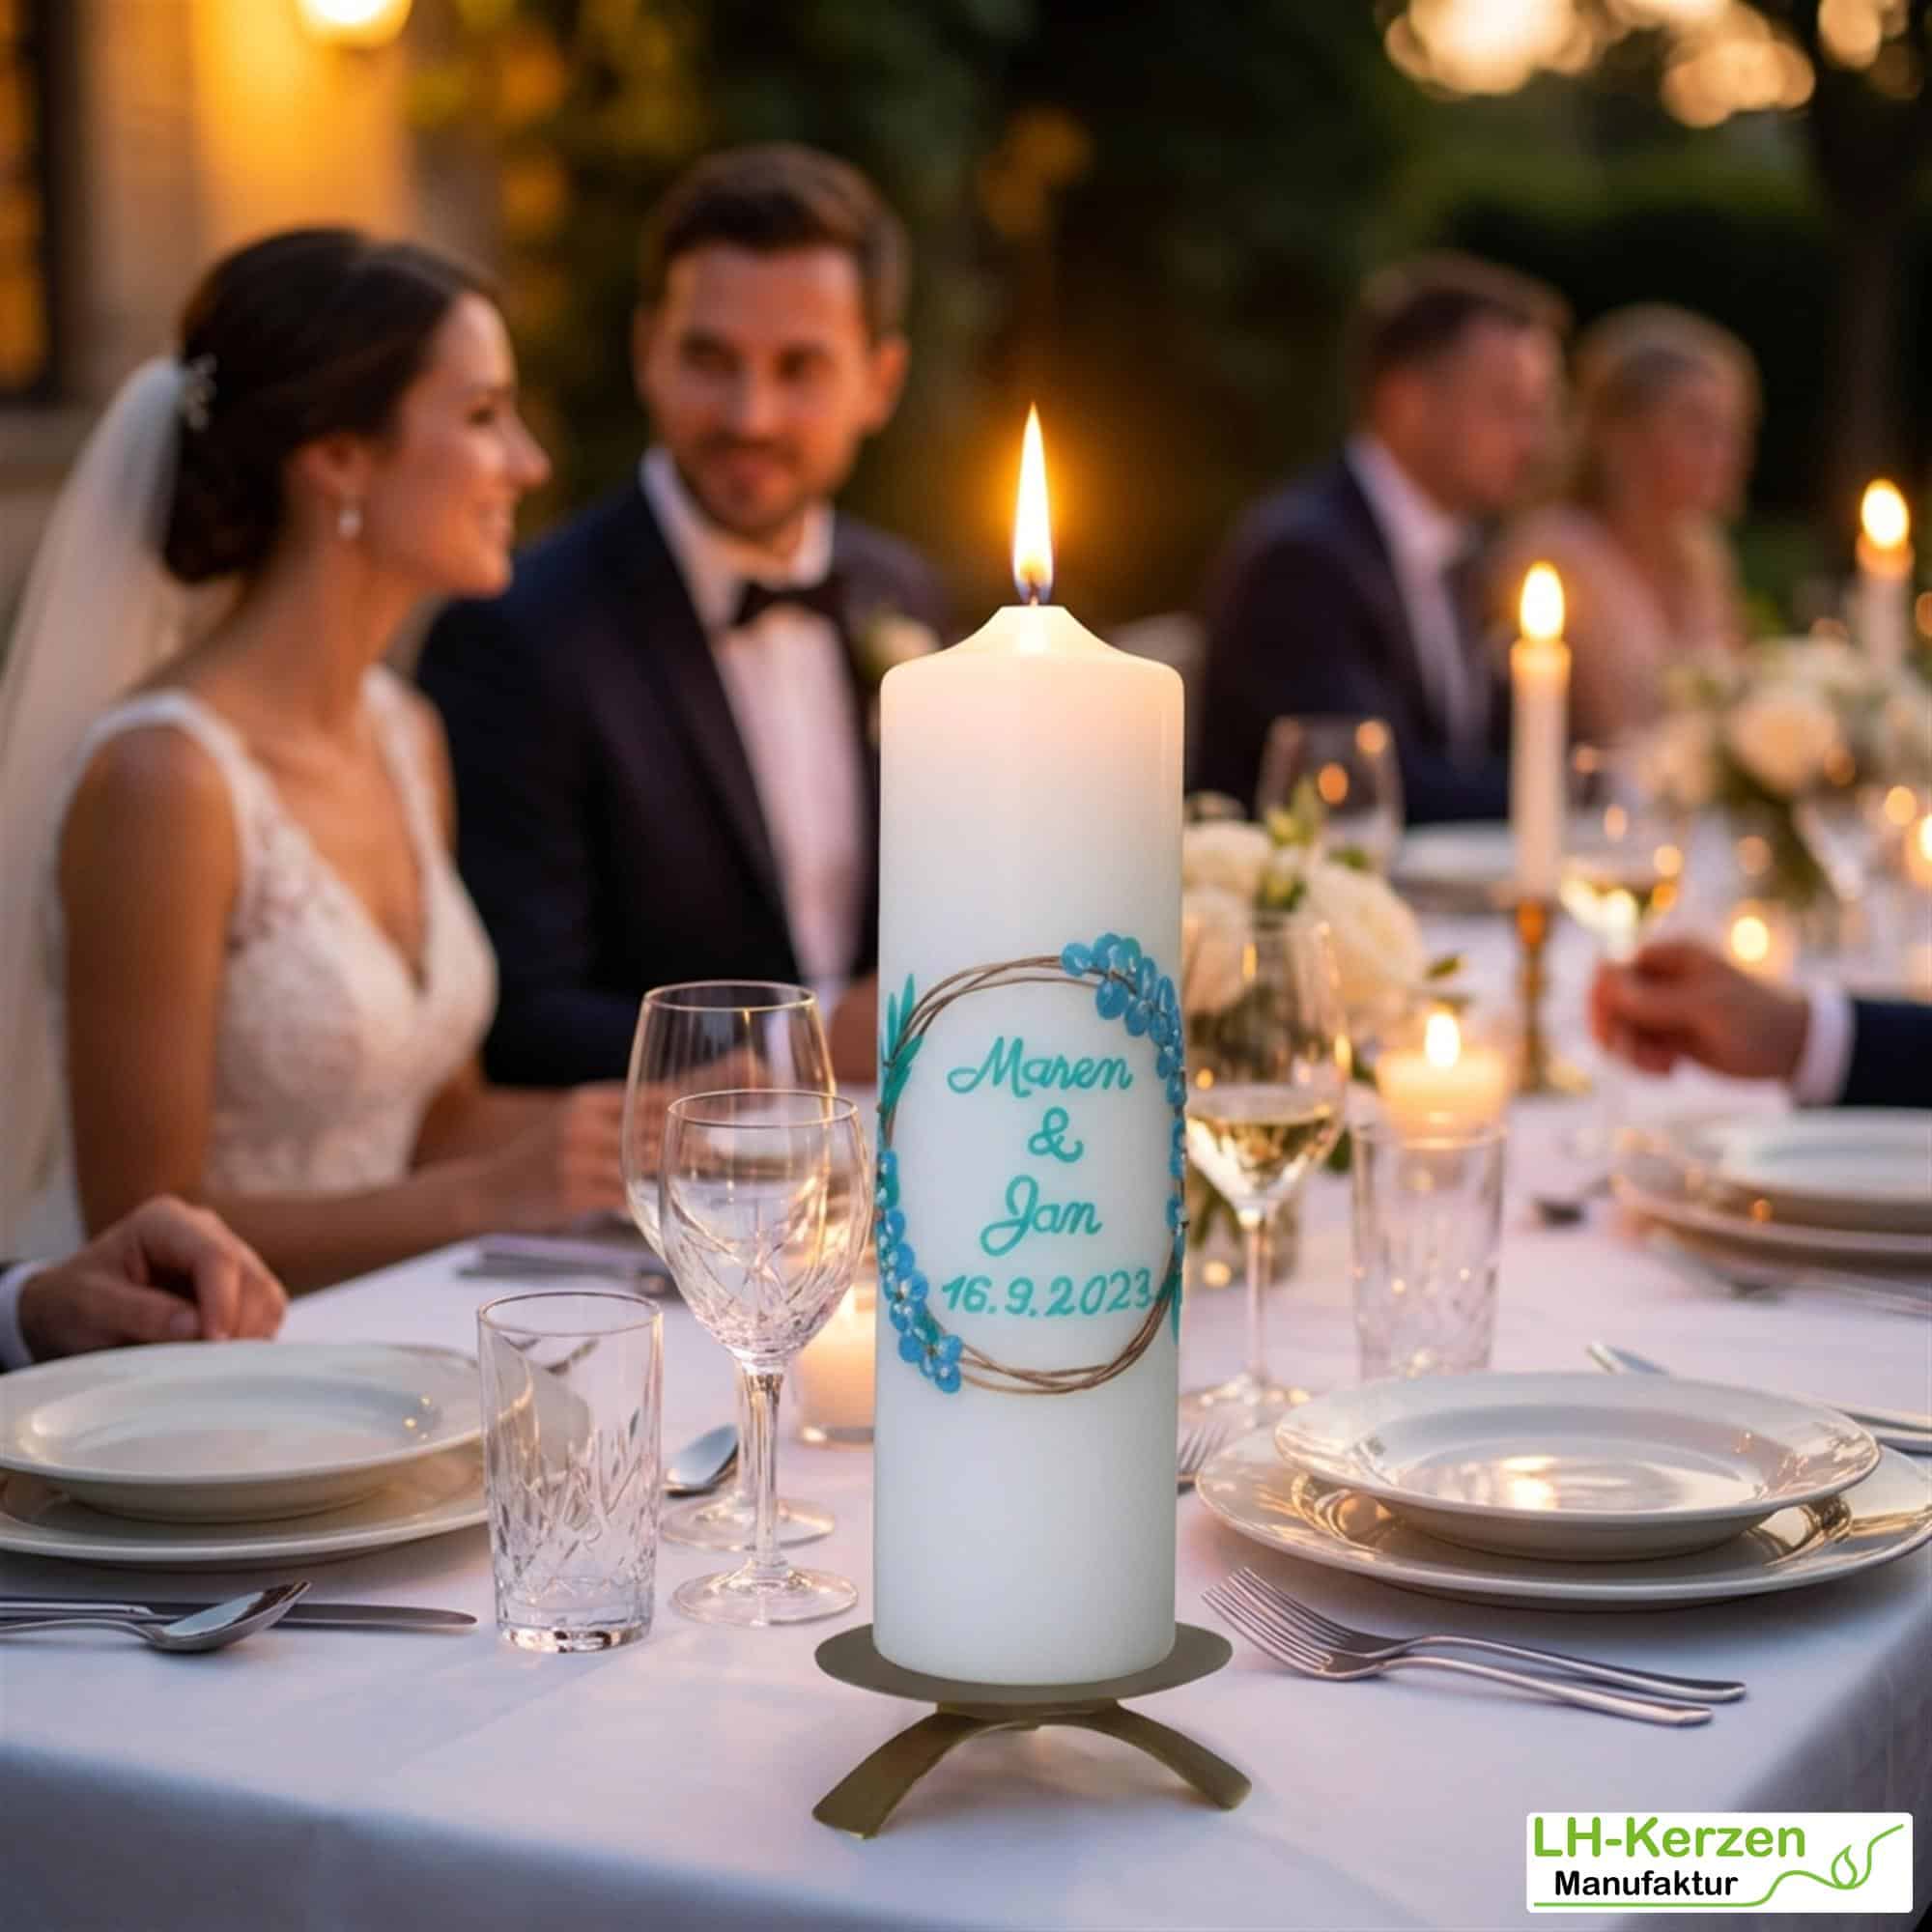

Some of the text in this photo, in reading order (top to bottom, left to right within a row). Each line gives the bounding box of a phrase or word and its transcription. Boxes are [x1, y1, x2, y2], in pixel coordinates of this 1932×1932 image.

[947, 1036, 1132, 1097] Maren
[1028, 1107, 1084, 1162] &
[980, 1175, 1102, 1257] Jan
[941, 1267, 1152, 1317] 16.9.2023
